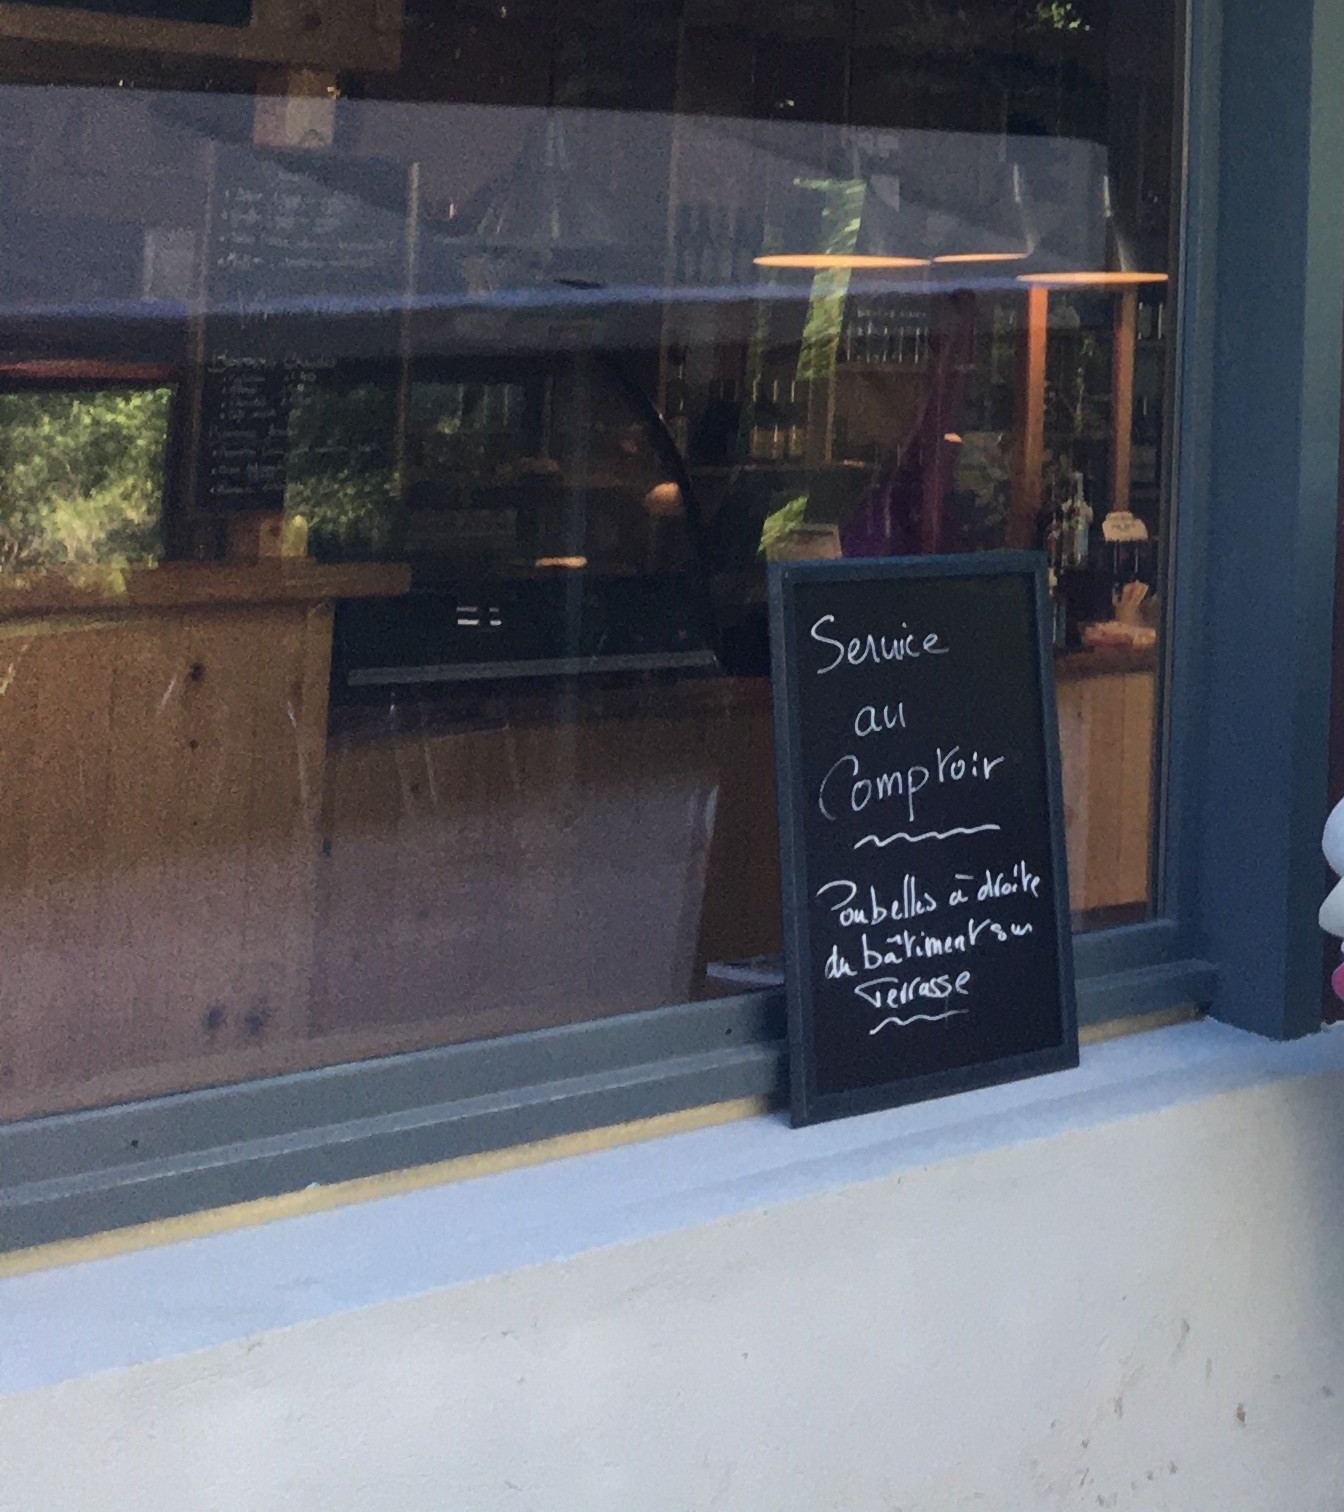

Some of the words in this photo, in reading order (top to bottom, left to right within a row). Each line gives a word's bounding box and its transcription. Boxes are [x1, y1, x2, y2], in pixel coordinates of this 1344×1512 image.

[811, 614, 949, 674] Service
[854, 702, 906, 738] au
[819, 746, 1004, 821] Comptoir
[816, 874, 937, 926] Poubelles
[977, 860, 1040, 901] droite
[825, 944, 857, 979] du
[854, 971, 970, 1008] Terrasse
